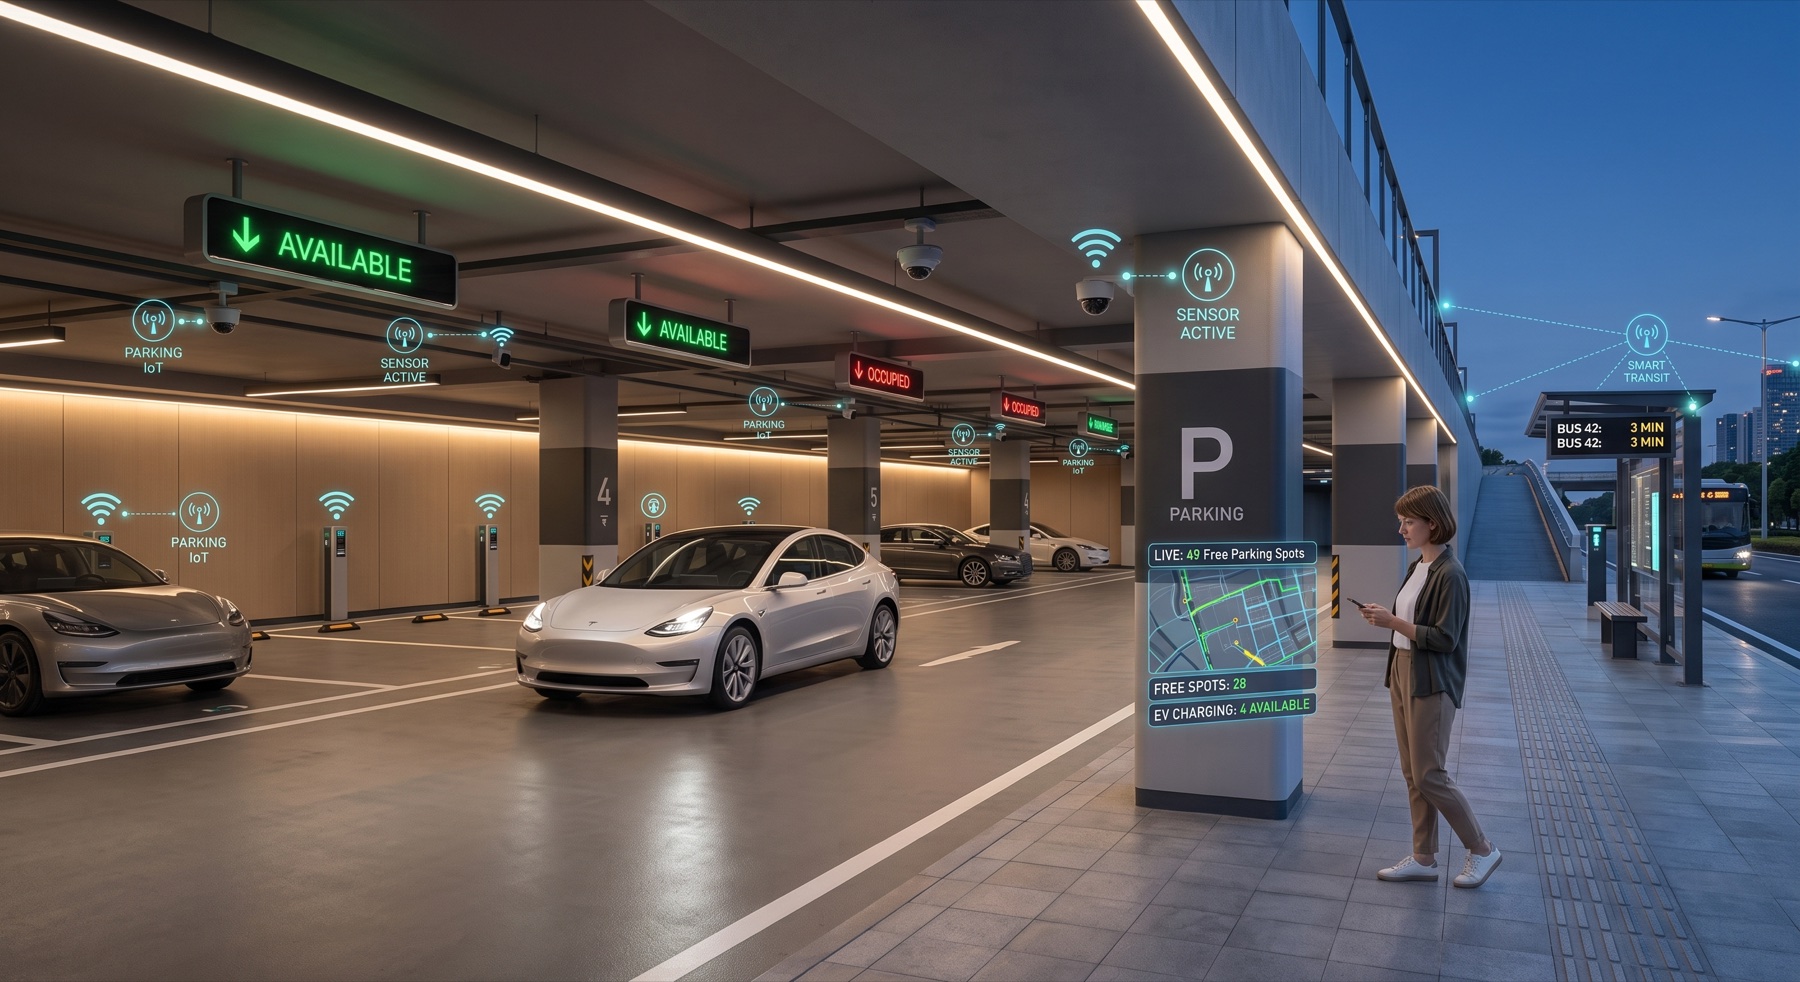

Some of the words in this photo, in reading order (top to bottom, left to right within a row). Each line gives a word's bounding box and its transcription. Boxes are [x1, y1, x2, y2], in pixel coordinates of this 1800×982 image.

[278, 231, 412, 283] AVAILABLE
[659, 319, 727, 351] AVAILABLE
[867, 366, 911, 390] OCCUPIED
[1011, 400, 1040, 418] OCCUPIED
[1557, 422, 1582, 434] BUS
[1584, 422, 1602, 433] 42:
[1630, 422, 1638, 433] 3
[1640, 421, 1664, 433] MIN
[1557, 437, 1582, 449] BUS
[1584, 437, 1602, 448] 42:
[1630, 437, 1638, 447] 3
[1640, 436, 1664, 447] MIN
[1181, 426, 1234, 500] P
[597, 477, 611, 506] 4
[870, 487, 878, 508] 5
[1169, 506, 1245, 522] PARKING
[1154, 549, 1184, 562] LIVE:
[1186, 548, 1200, 561] 49
[1203, 548, 1229, 561] Free
[1231, 547, 1273, 562] Parking
[1275, 547, 1305, 562] Spots
[1154, 681, 1185, 696] FREE
[1188, 679, 1230, 693] SPOTS:
[1233, 677, 1247, 690] 28
[1154, 708, 1170, 722] EV
[1172, 703, 1237, 720] CHARGING:
[1239, 702, 1247, 715] 4
[1249, 698, 1310, 715] AVAILABLE
